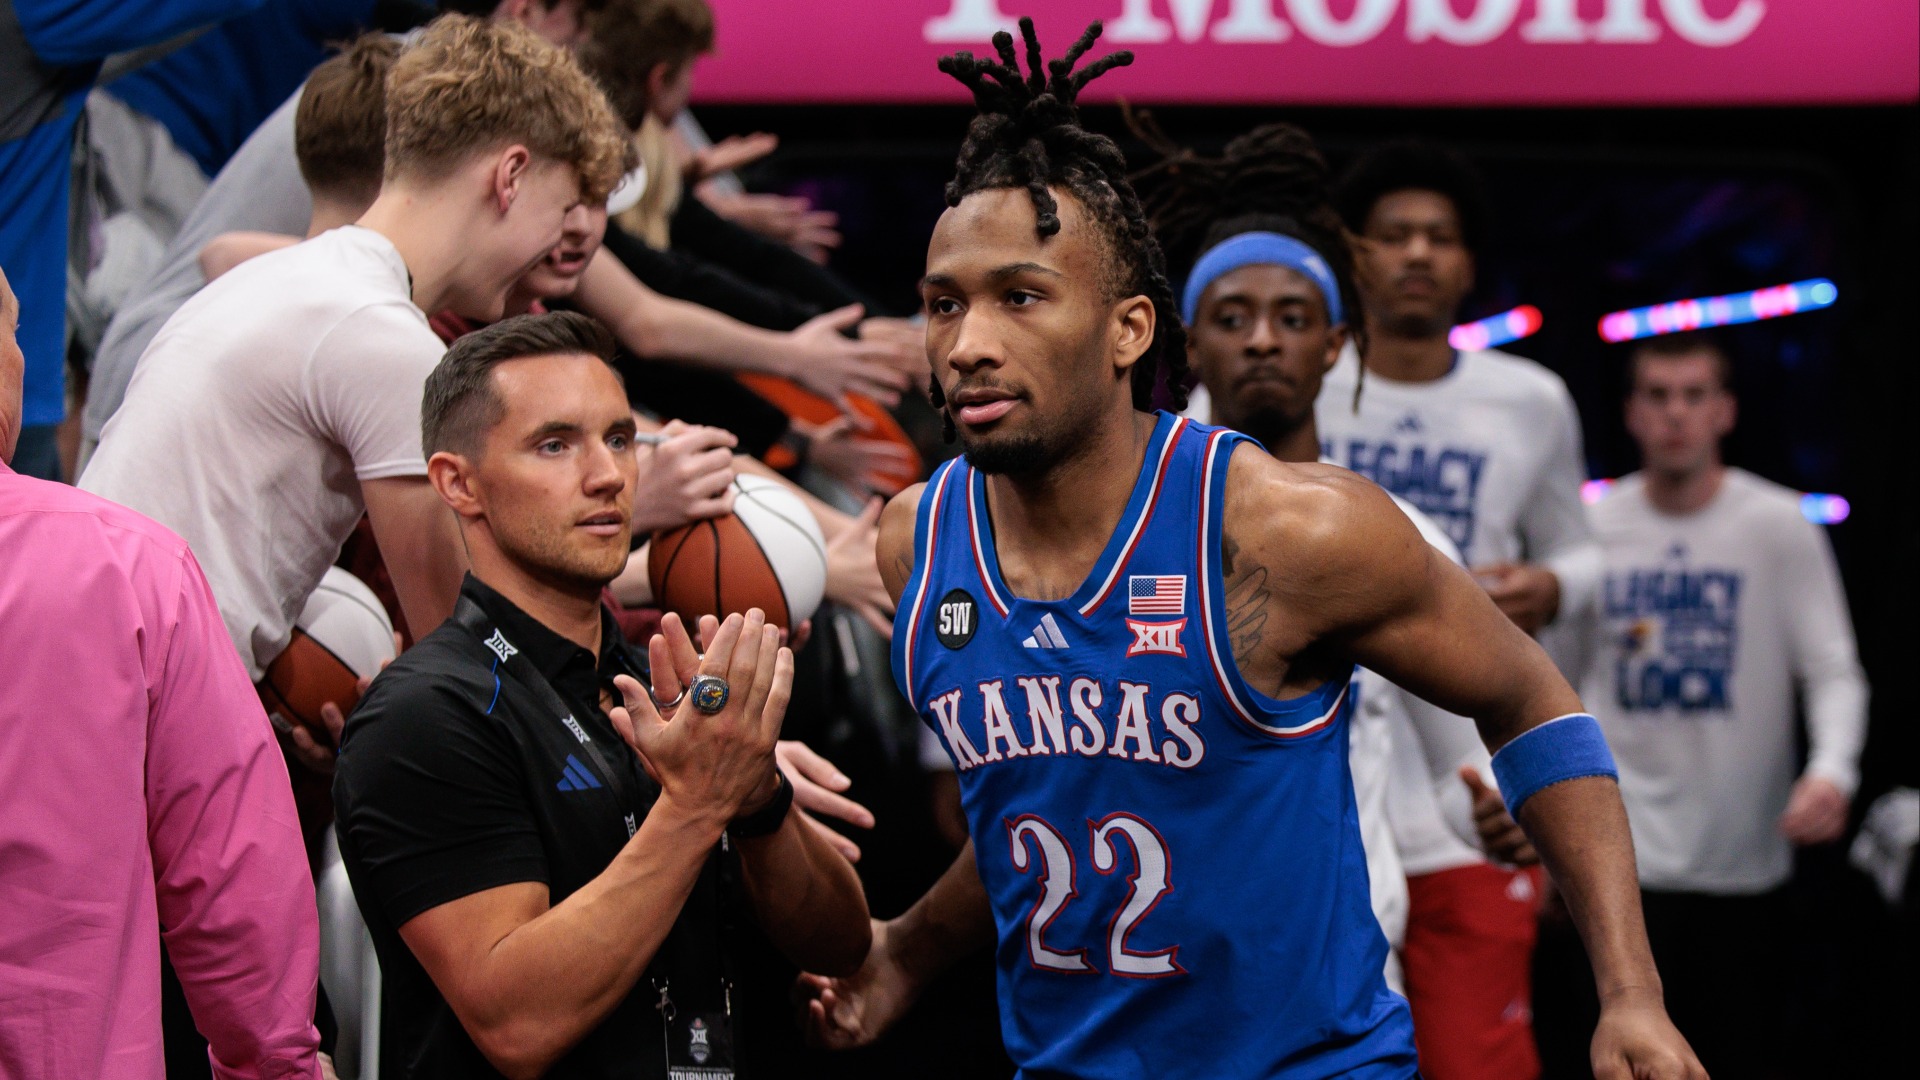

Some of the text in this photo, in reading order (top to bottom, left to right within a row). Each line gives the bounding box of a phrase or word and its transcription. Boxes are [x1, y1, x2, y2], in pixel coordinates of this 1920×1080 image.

[939, 601, 972, 635] SW
[1127, 618, 1187, 657] XII
[929, 676, 1206, 771] KANSAS
[1003, 811, 1188, 978] 22
